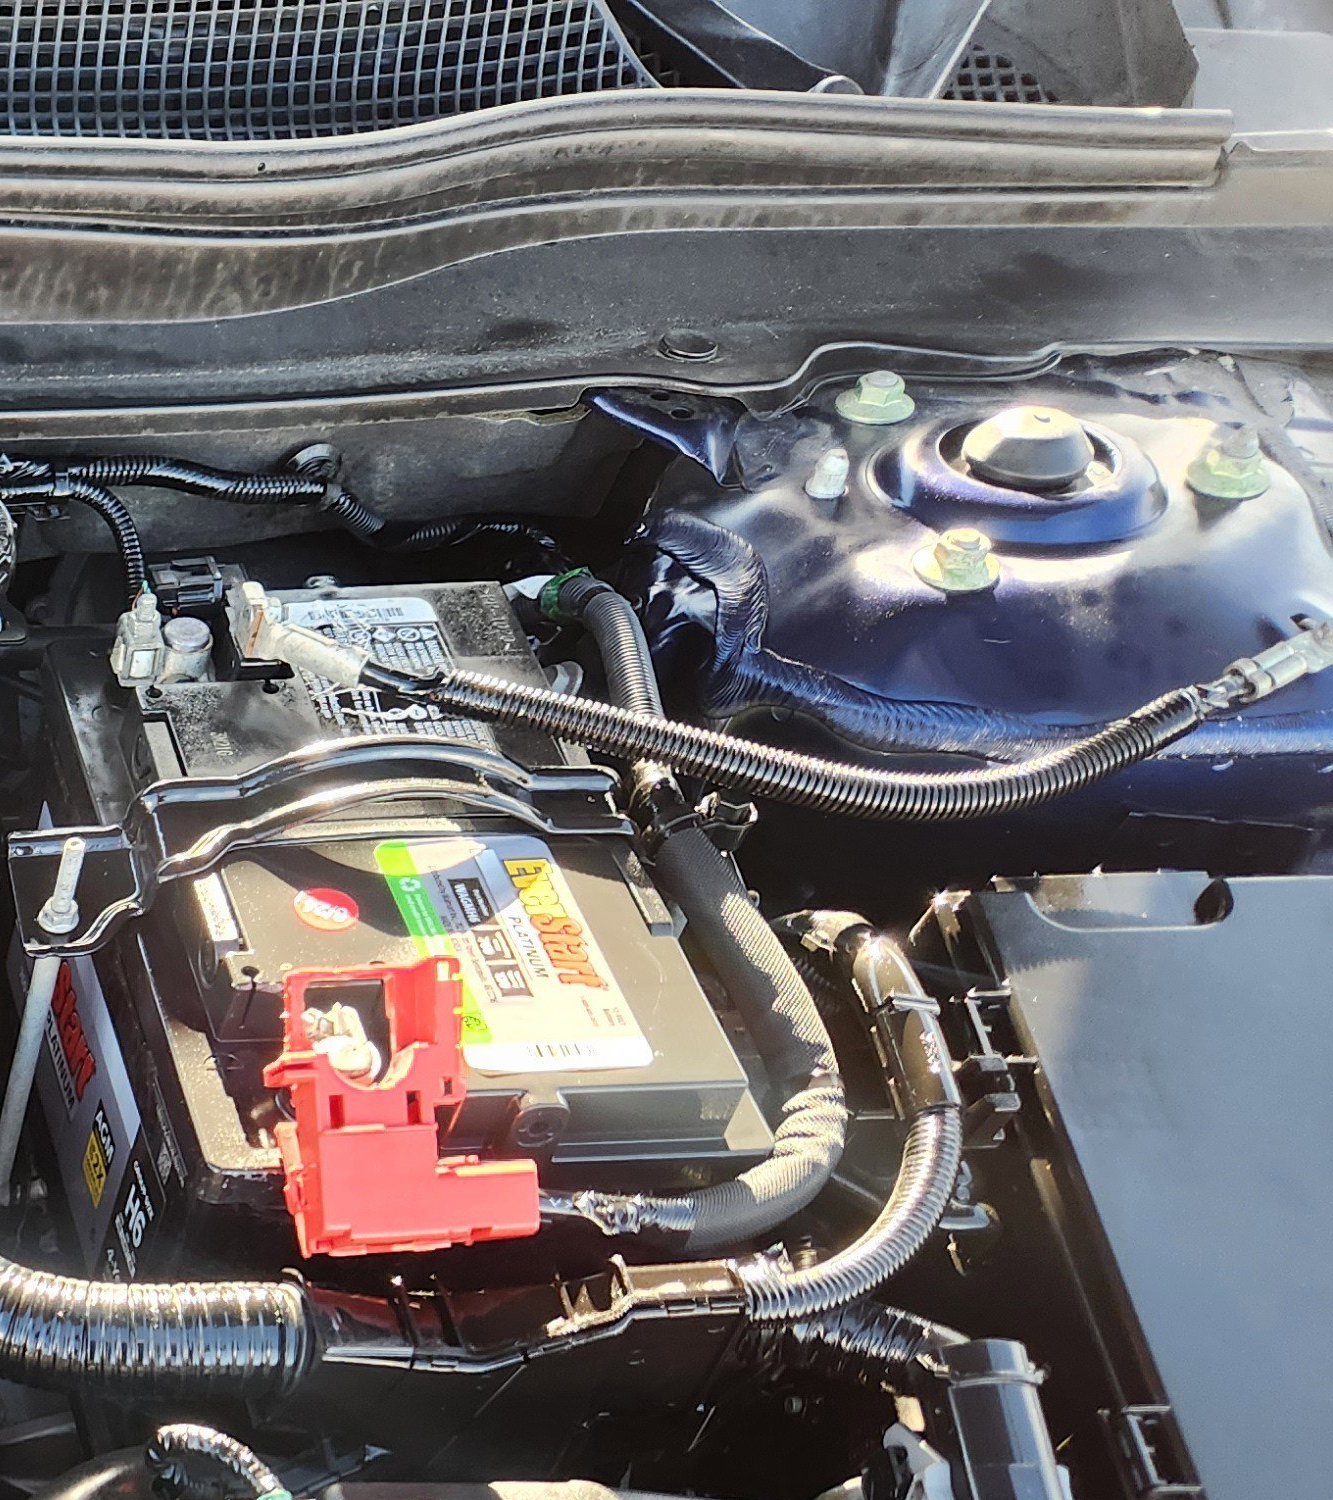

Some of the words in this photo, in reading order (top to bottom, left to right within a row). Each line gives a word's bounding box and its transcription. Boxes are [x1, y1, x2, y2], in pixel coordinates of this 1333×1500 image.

[508, 916, 549, 979] PLATINUM
[95, 1109, 116, 1164] AGM
[124, 1183, 146, 1249] H6
